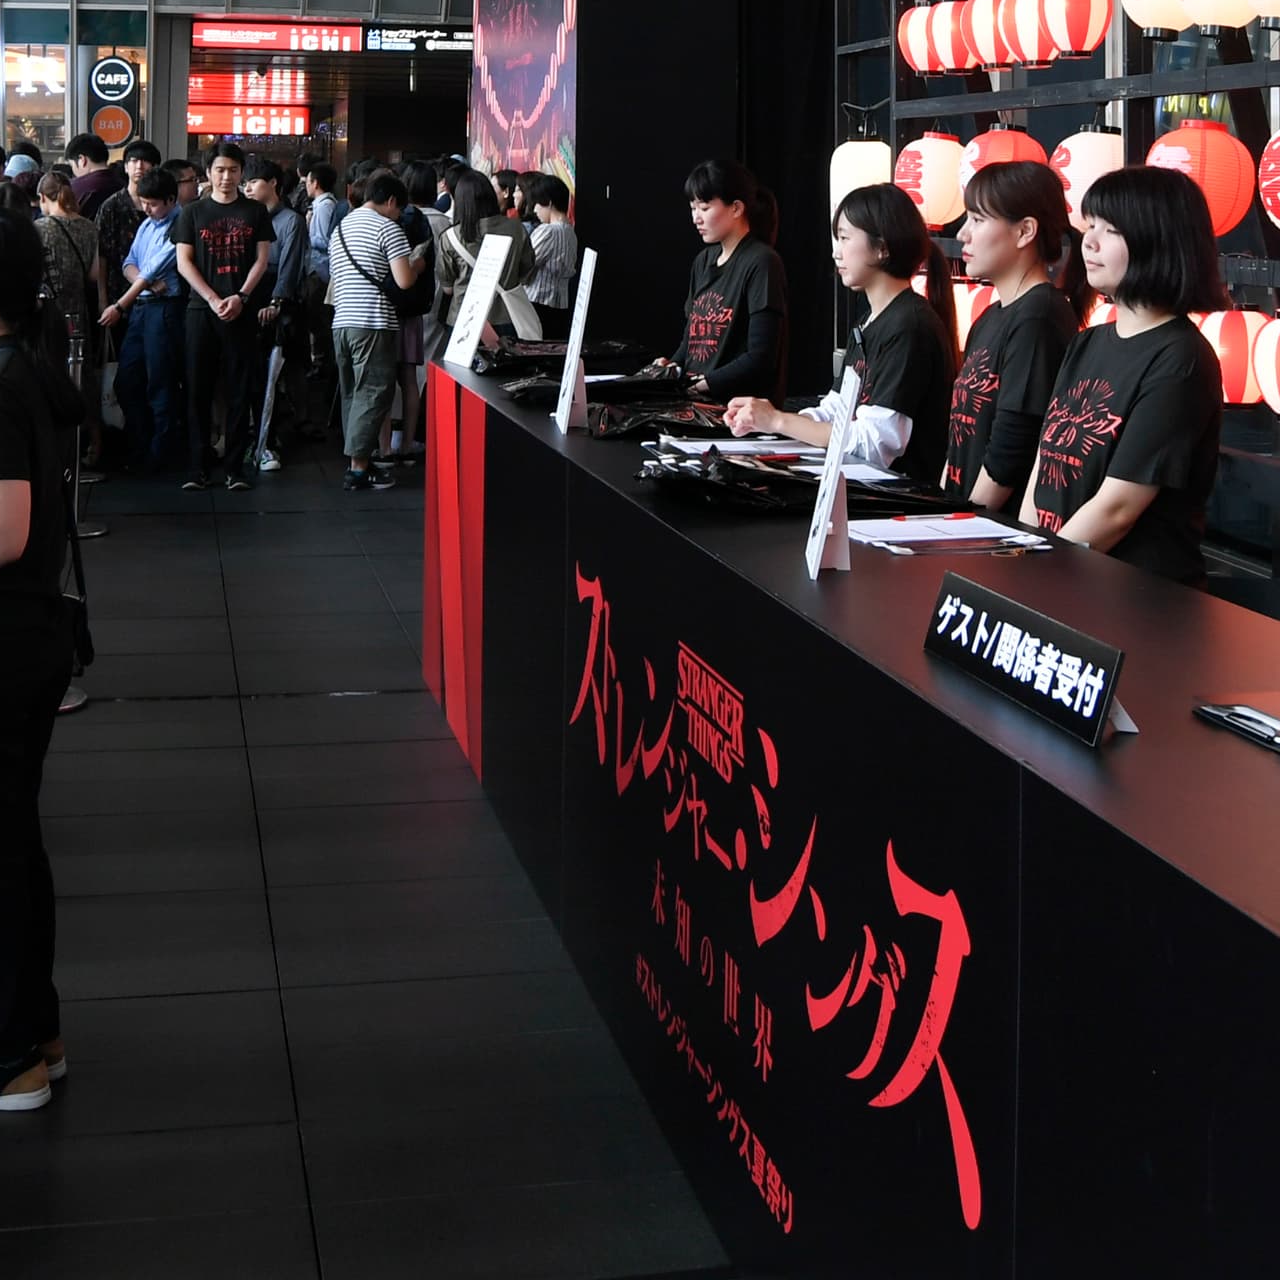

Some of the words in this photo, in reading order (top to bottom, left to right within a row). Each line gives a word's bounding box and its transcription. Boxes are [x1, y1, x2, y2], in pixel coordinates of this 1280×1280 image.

[97, 73, 128, 86] CAFE
[289, 35, 351, 51] ICHI
[232, 116, 305, 135] ICHI
[937, 594, 1105, 718] ゲスト/関係者受付
[677, 648, 744, 758] STRANGER
[686, 703, 733, 784] THINGS
[650, 858, 773, 1083] 未知の世界
